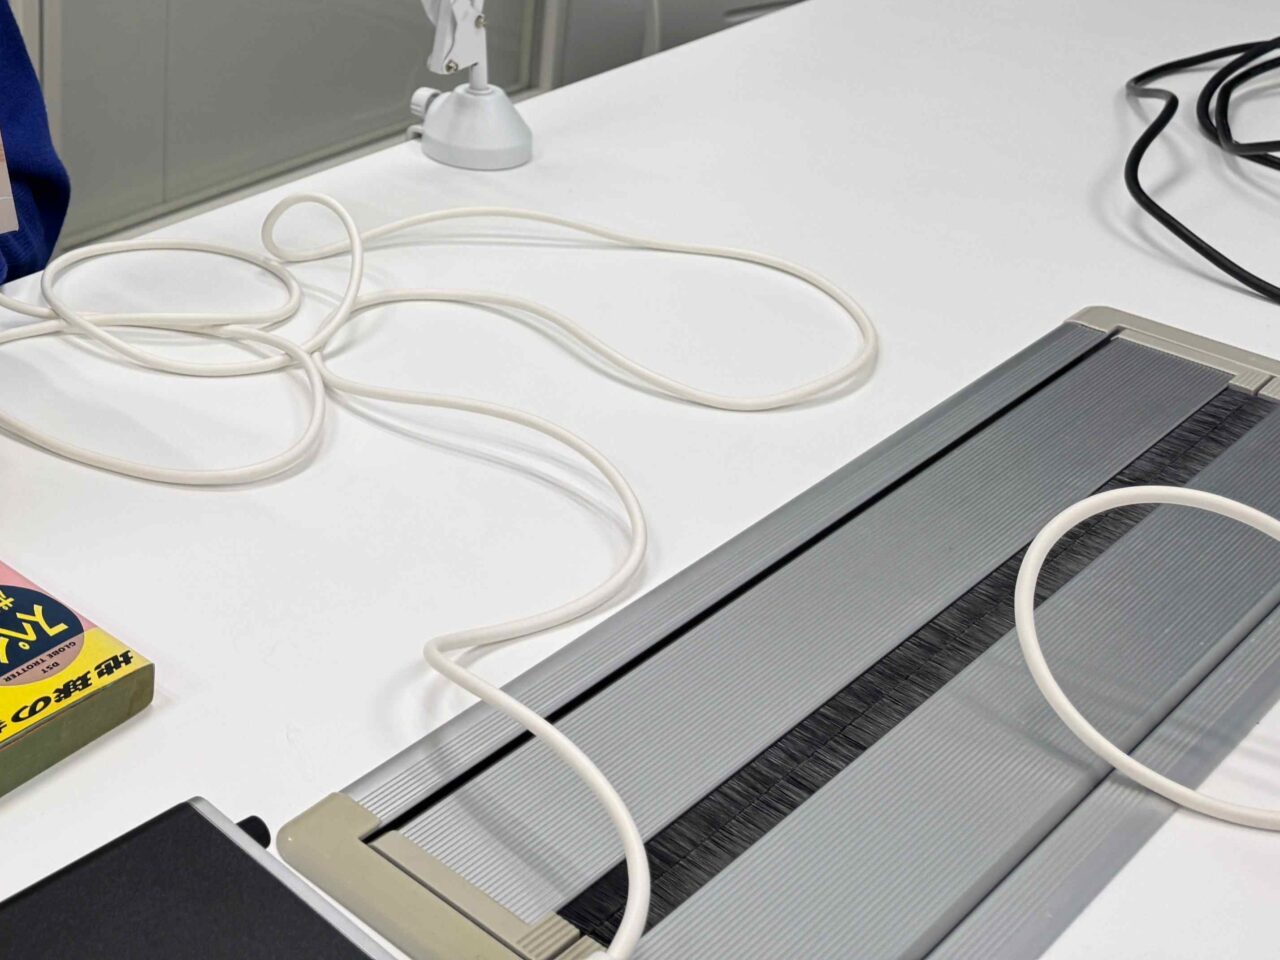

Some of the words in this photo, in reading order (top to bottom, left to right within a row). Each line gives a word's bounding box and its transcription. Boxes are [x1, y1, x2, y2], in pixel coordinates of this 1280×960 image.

[47, 641, 77, 659] GLOBE
[3, 658, 46, 683] TROTTER
[42, 661, 60, 674] DST
